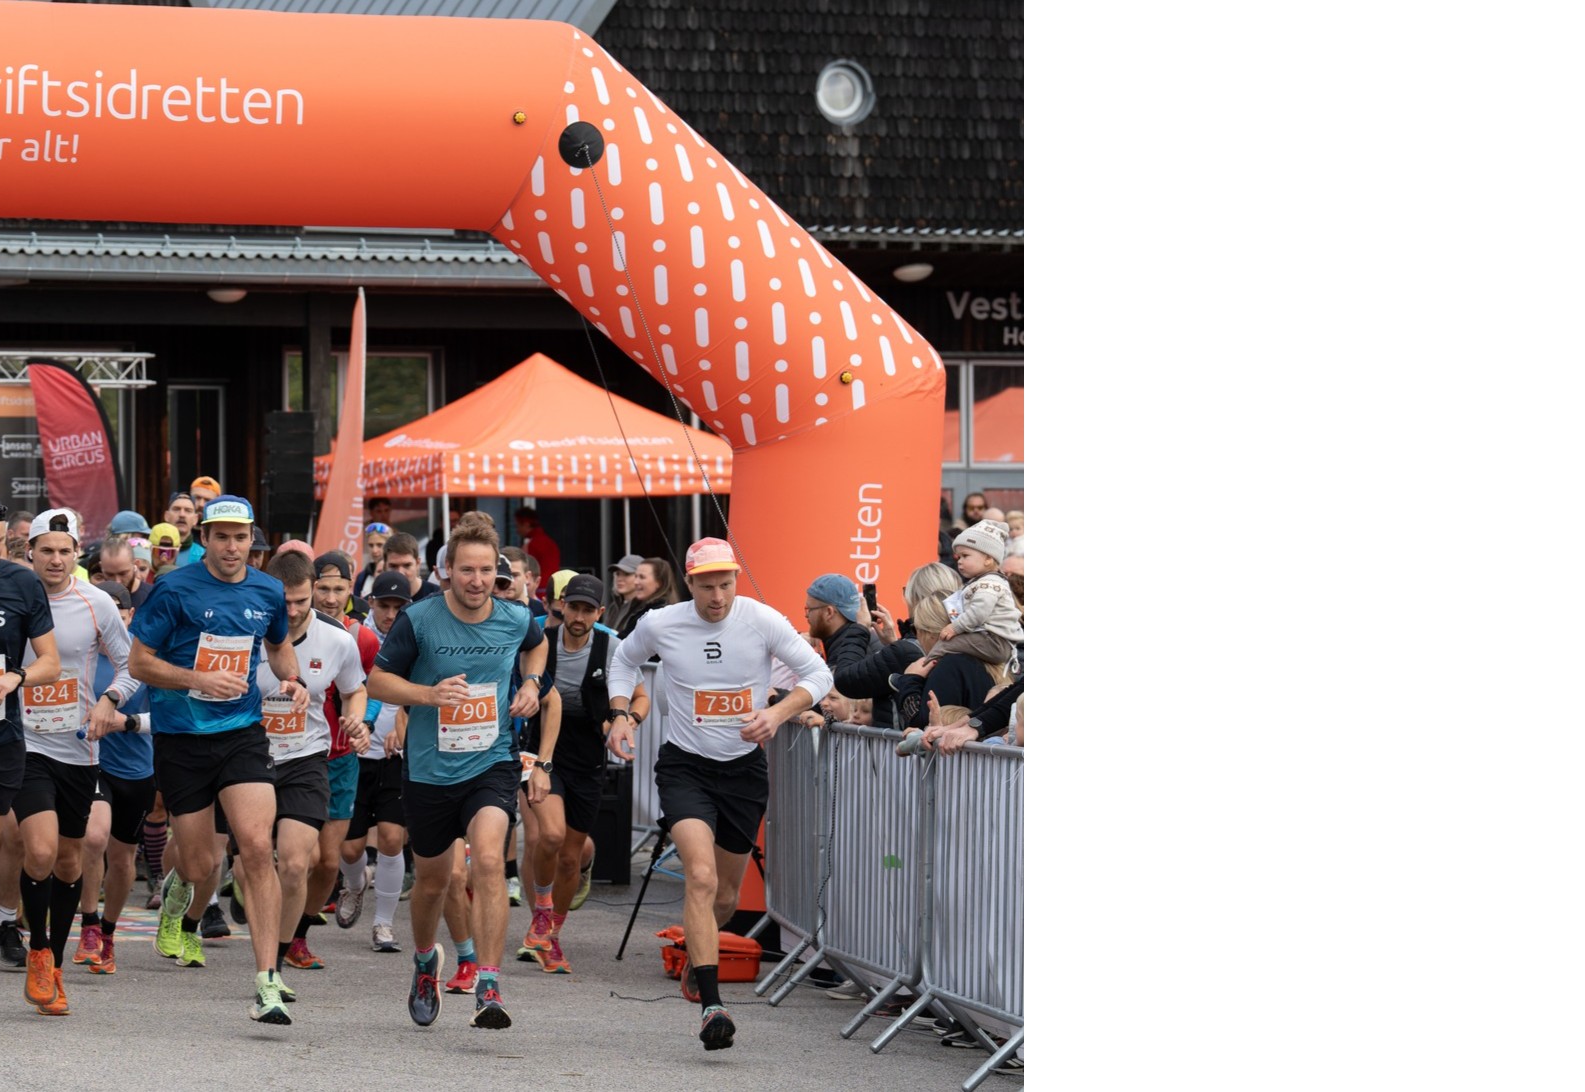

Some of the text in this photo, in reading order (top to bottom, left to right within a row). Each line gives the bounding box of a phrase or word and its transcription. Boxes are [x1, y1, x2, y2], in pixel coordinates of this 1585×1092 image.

[20, 131, 79, 163] alt!
[946, 291, 1024, 320] Vest
[48, 430, 103, 453] URBAN
[52, 449, 106, 470] CIRCUS
[213, 505, 242, 515] HOKA
[850, 483, 882, 592] etten
[434, 646, 510, 657] DYNAFIT
[207, 653, 241, 672] 701
[32, 684, 69, 703] 824
[451, 701, 487, 721] 790
[705, 695, 744, 712] 730
[264, 716, 297, 731] 734
